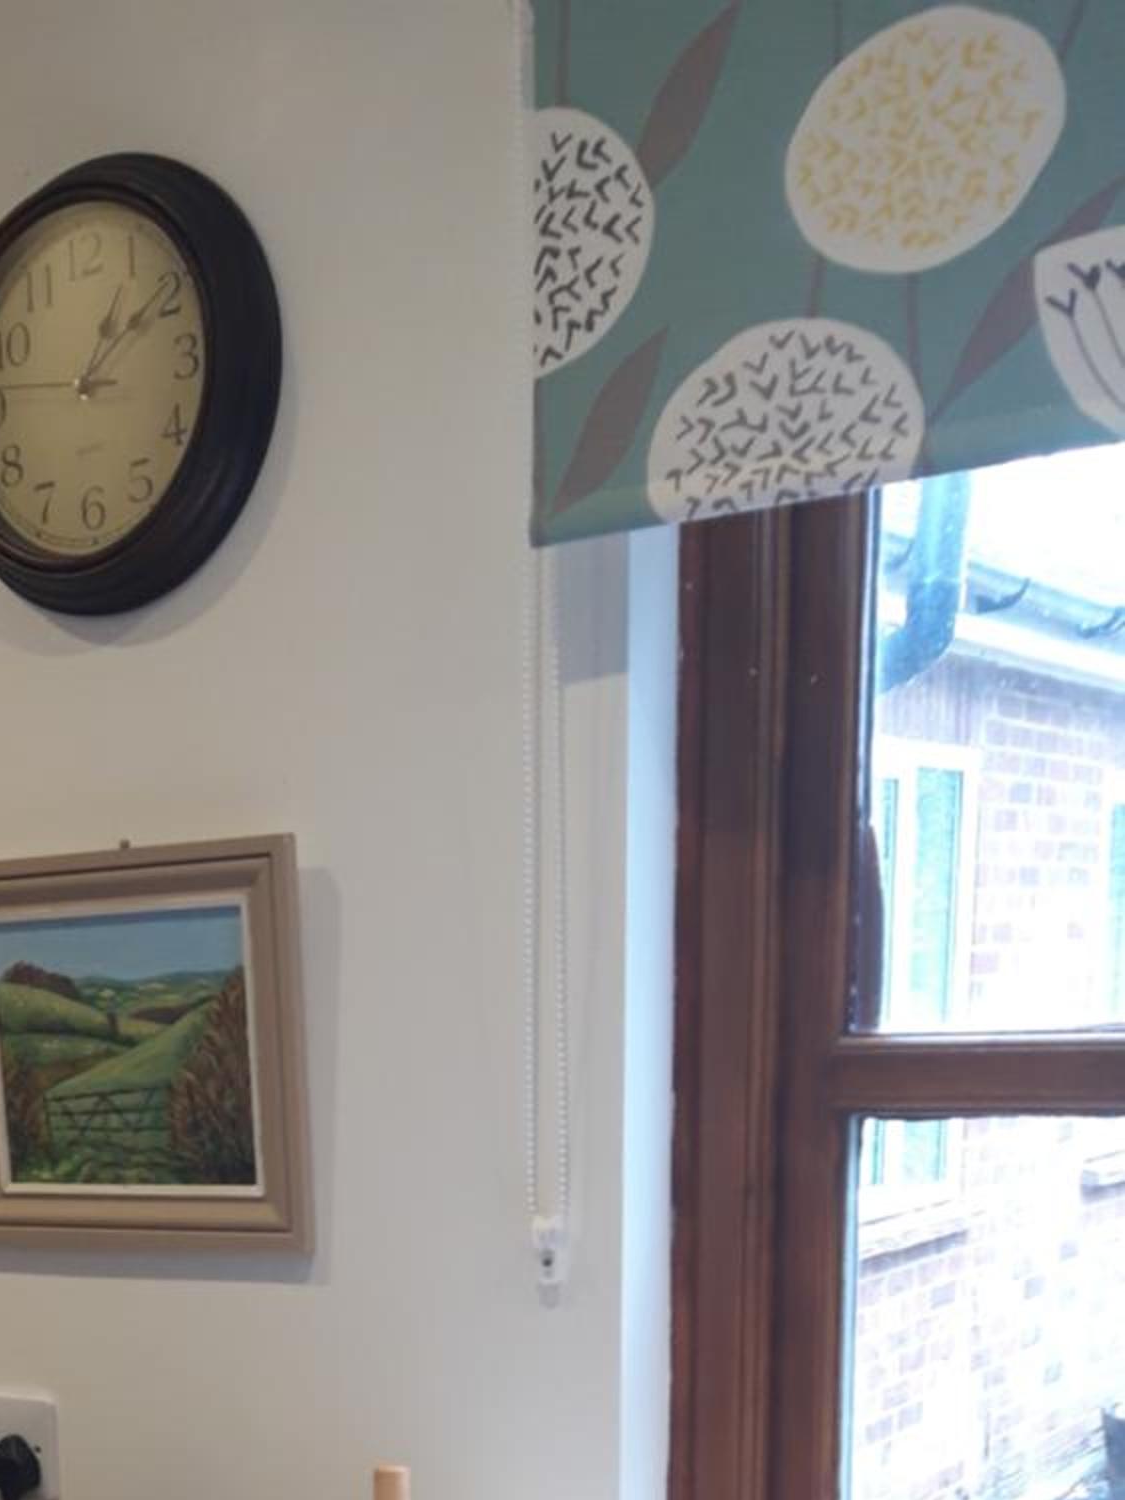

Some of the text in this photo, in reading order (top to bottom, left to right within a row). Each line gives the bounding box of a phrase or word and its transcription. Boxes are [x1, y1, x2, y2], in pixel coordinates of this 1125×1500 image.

[68, 231, 104, 282] 12
[127, 234, 137, 279] 1
[24, 262, 54, 313] 11
[157, 270, 183, 319] 2
[173, 332, 200, 381] 3
[160, 402, 187, 446] 4
[0, 444, 24, 489] 8
[127, 456, 154, 503] 5
[33, 480, 56, 525] 7
[81, 485, 106, 531] 6
